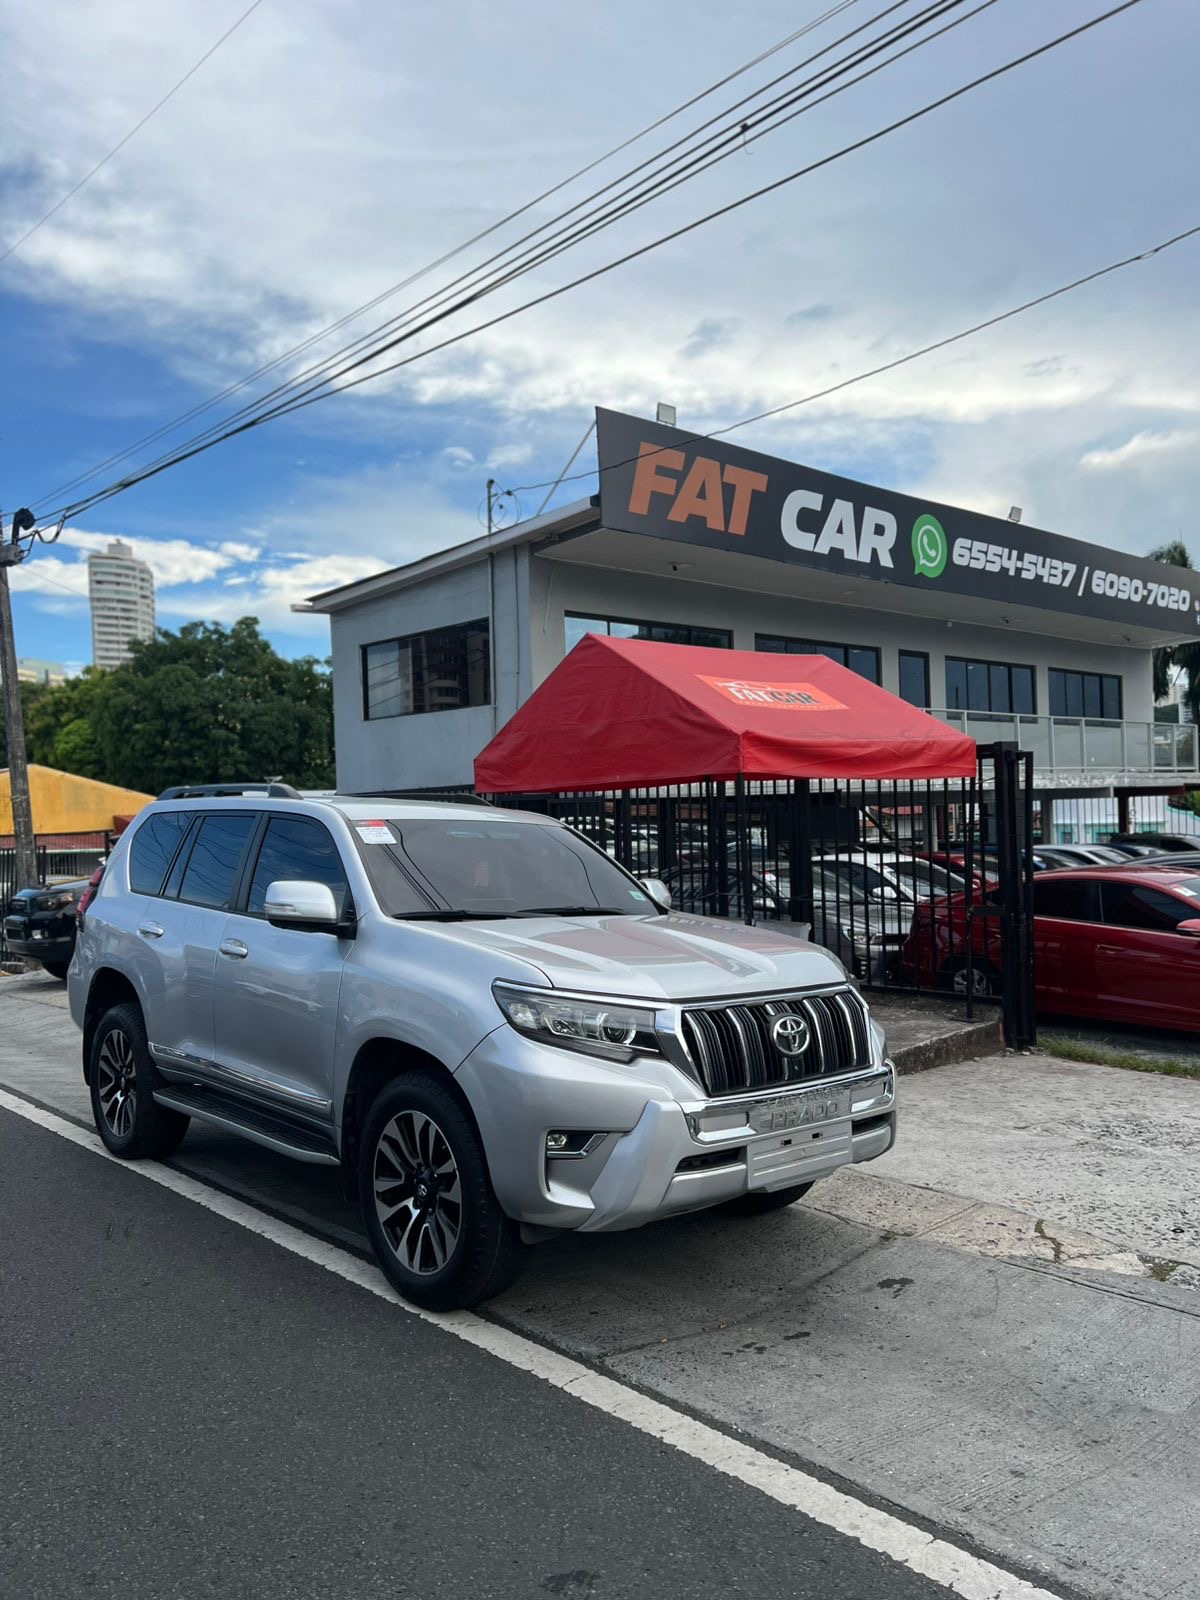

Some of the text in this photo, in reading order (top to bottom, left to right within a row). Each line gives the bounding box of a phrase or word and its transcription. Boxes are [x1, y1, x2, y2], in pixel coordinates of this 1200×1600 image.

[628, 441, 1190, 612] FAT CAR 6554-5437 / 6090-7020
[770, 1101, 840, 1131] PRADO
